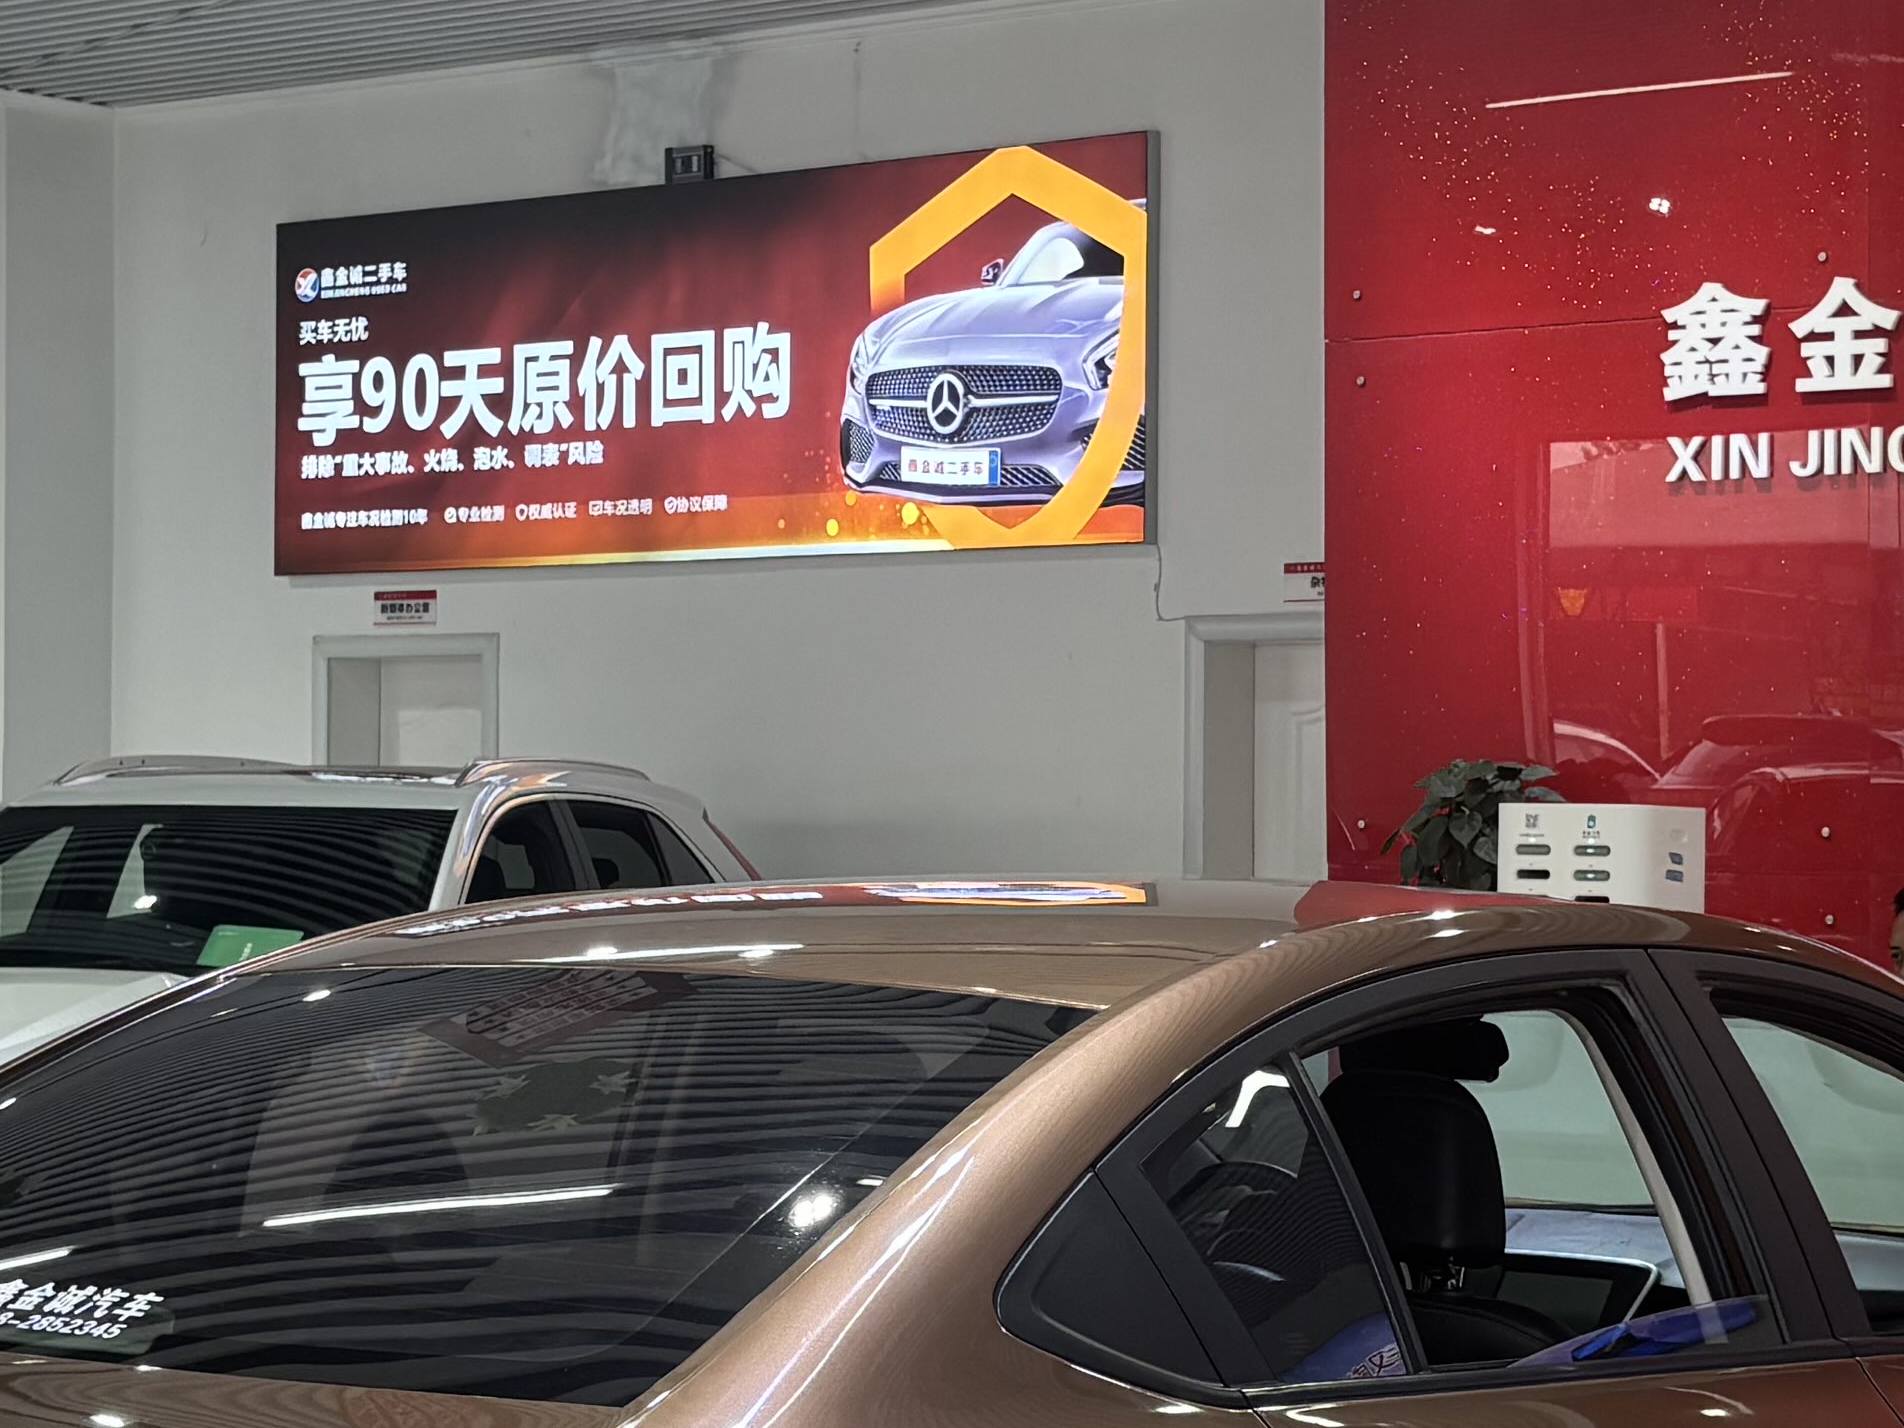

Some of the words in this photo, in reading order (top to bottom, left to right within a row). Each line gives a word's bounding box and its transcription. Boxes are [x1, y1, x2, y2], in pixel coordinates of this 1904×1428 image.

[299, 316, 369, 346] 买车无忧
[297, 321, 792, 448] 享90天原价回购
[1665, 432, 1773, 484] XIN
[528, 500, 578, 521] 权威认证
[603, 497, 653, 518] 车况透明
[676, 494, 729, 515] 协议保障
